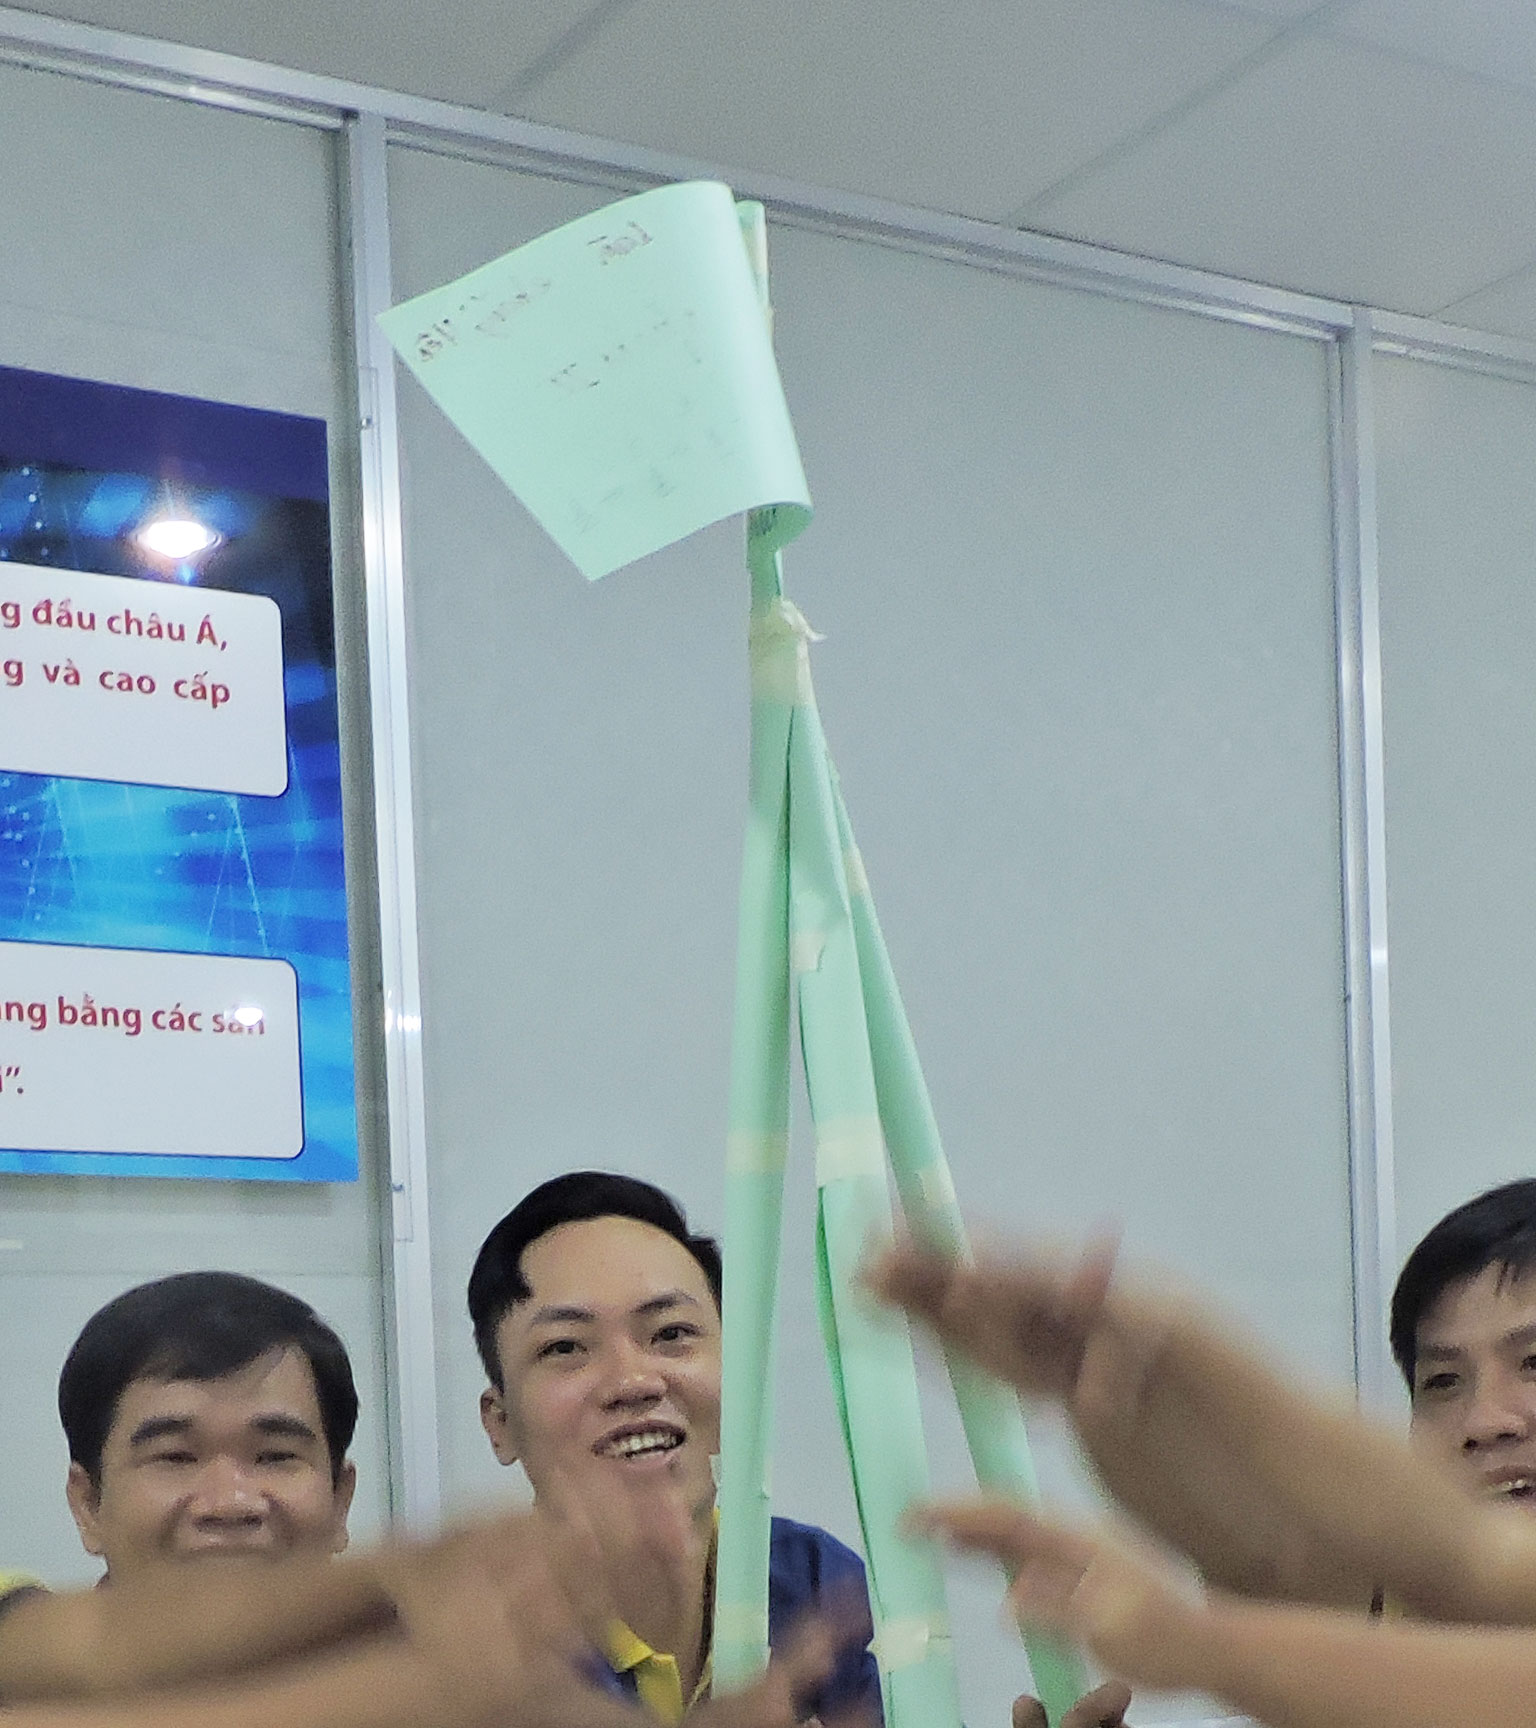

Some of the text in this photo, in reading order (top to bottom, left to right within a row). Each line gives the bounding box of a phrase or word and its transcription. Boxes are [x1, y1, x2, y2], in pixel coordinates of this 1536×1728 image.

[106, 610, 185, 642] châu
[195, 615, 227, 650] Á,
[42, 655, 81, 688] và
[98, 668, 156, 696] cao
[172, 672, 231, 710] cấp
[58, 996, 141, 1037] bằng
[151, 1004, 202, 1035] các
